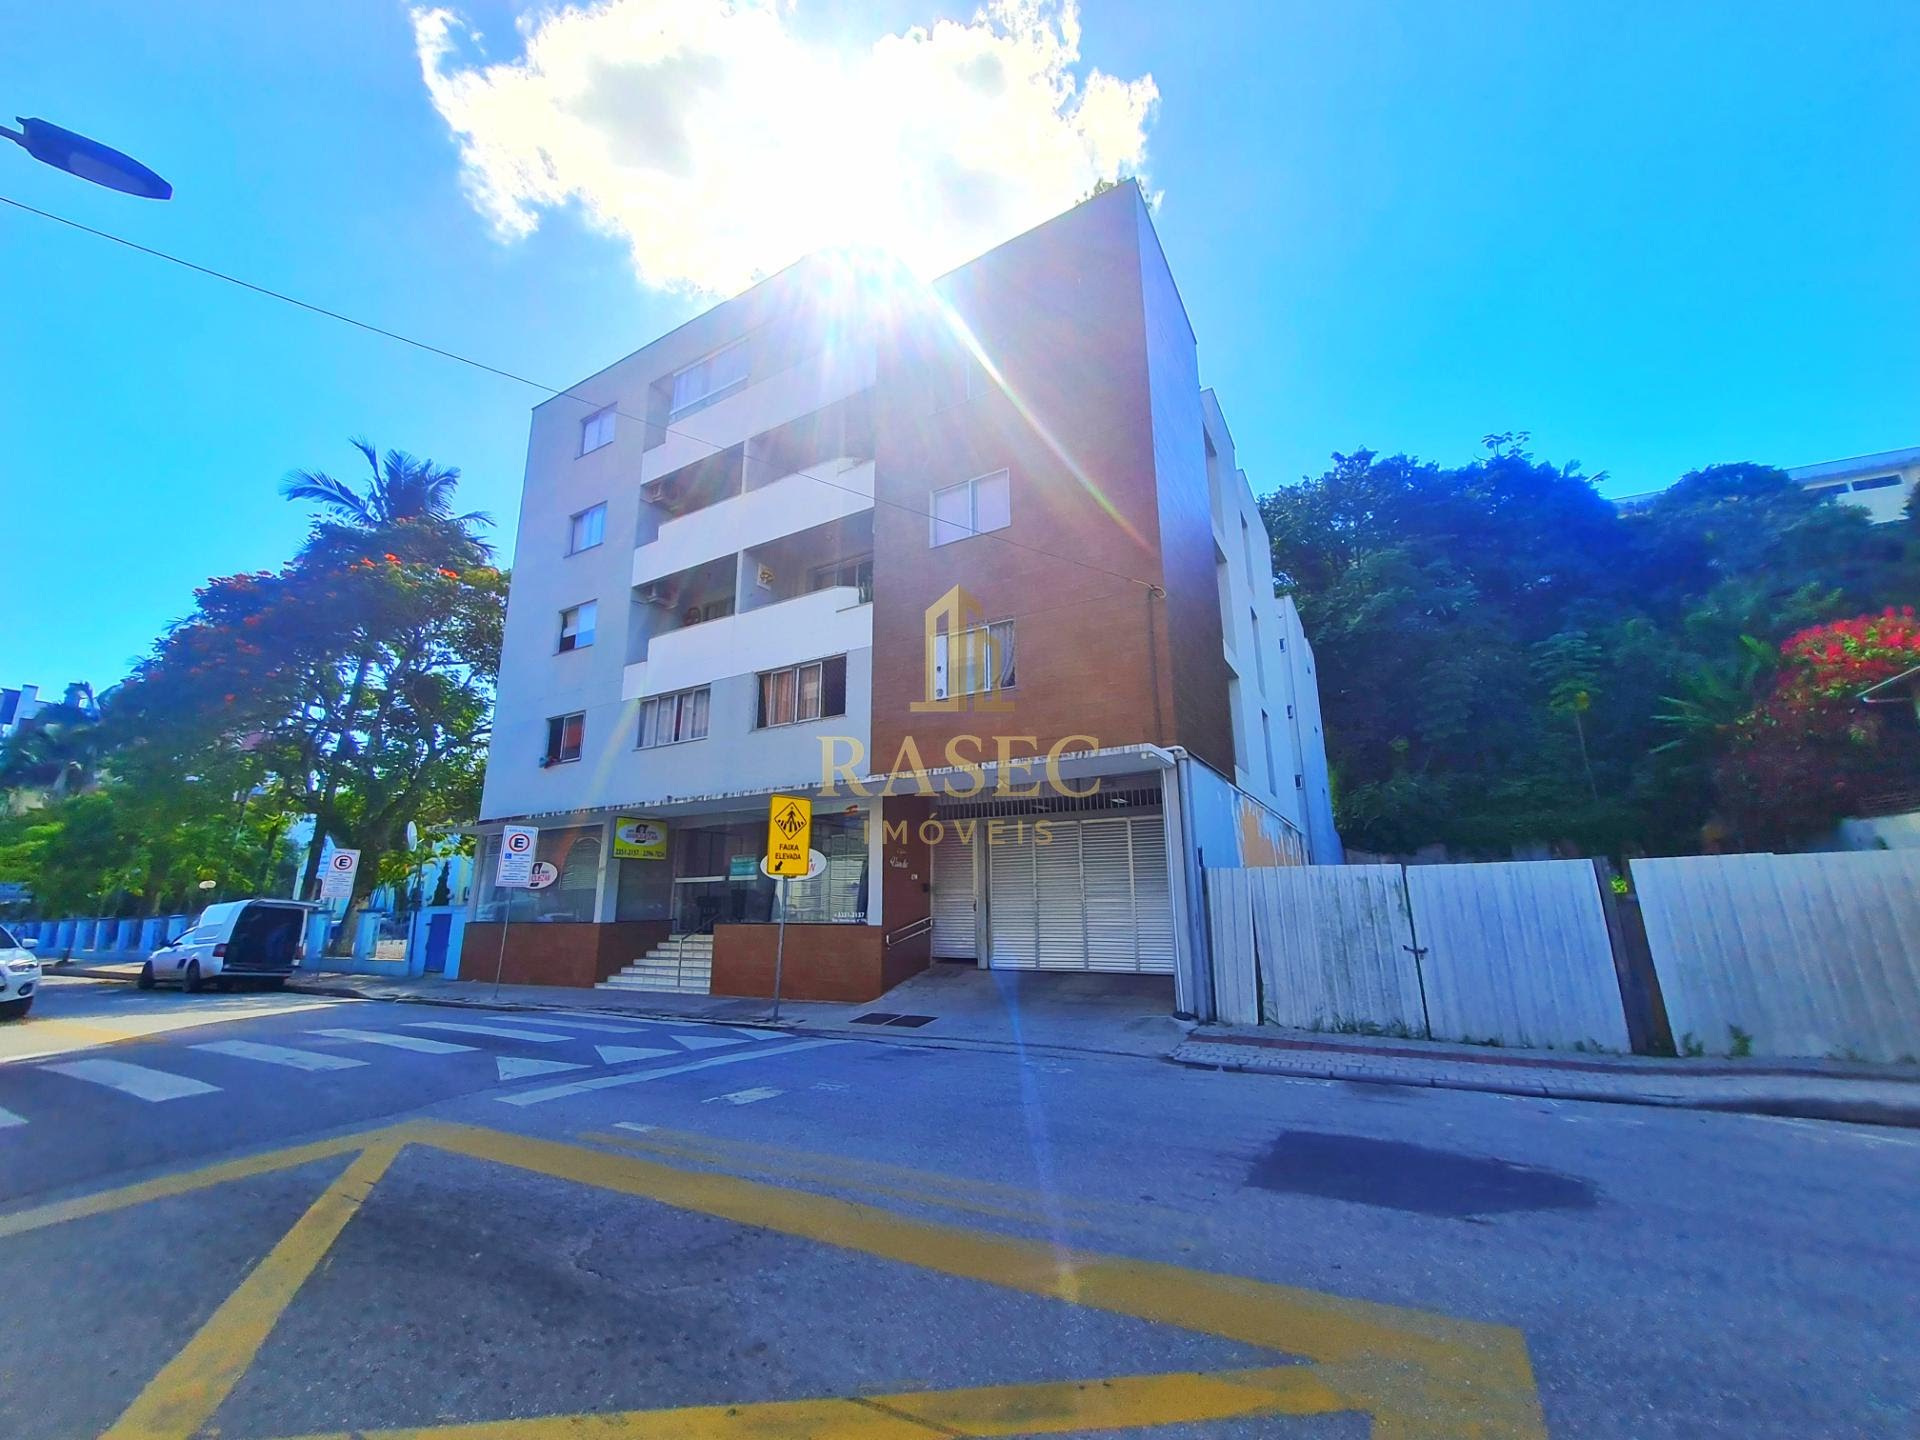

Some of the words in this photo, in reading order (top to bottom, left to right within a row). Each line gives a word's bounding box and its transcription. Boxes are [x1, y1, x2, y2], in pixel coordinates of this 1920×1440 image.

[514, 838, 525, 848] E
[779, 843, 799, 851] FAIXA
[775, 852, 801, 860] ELEVADA
[339, 859, 348, 867] E
